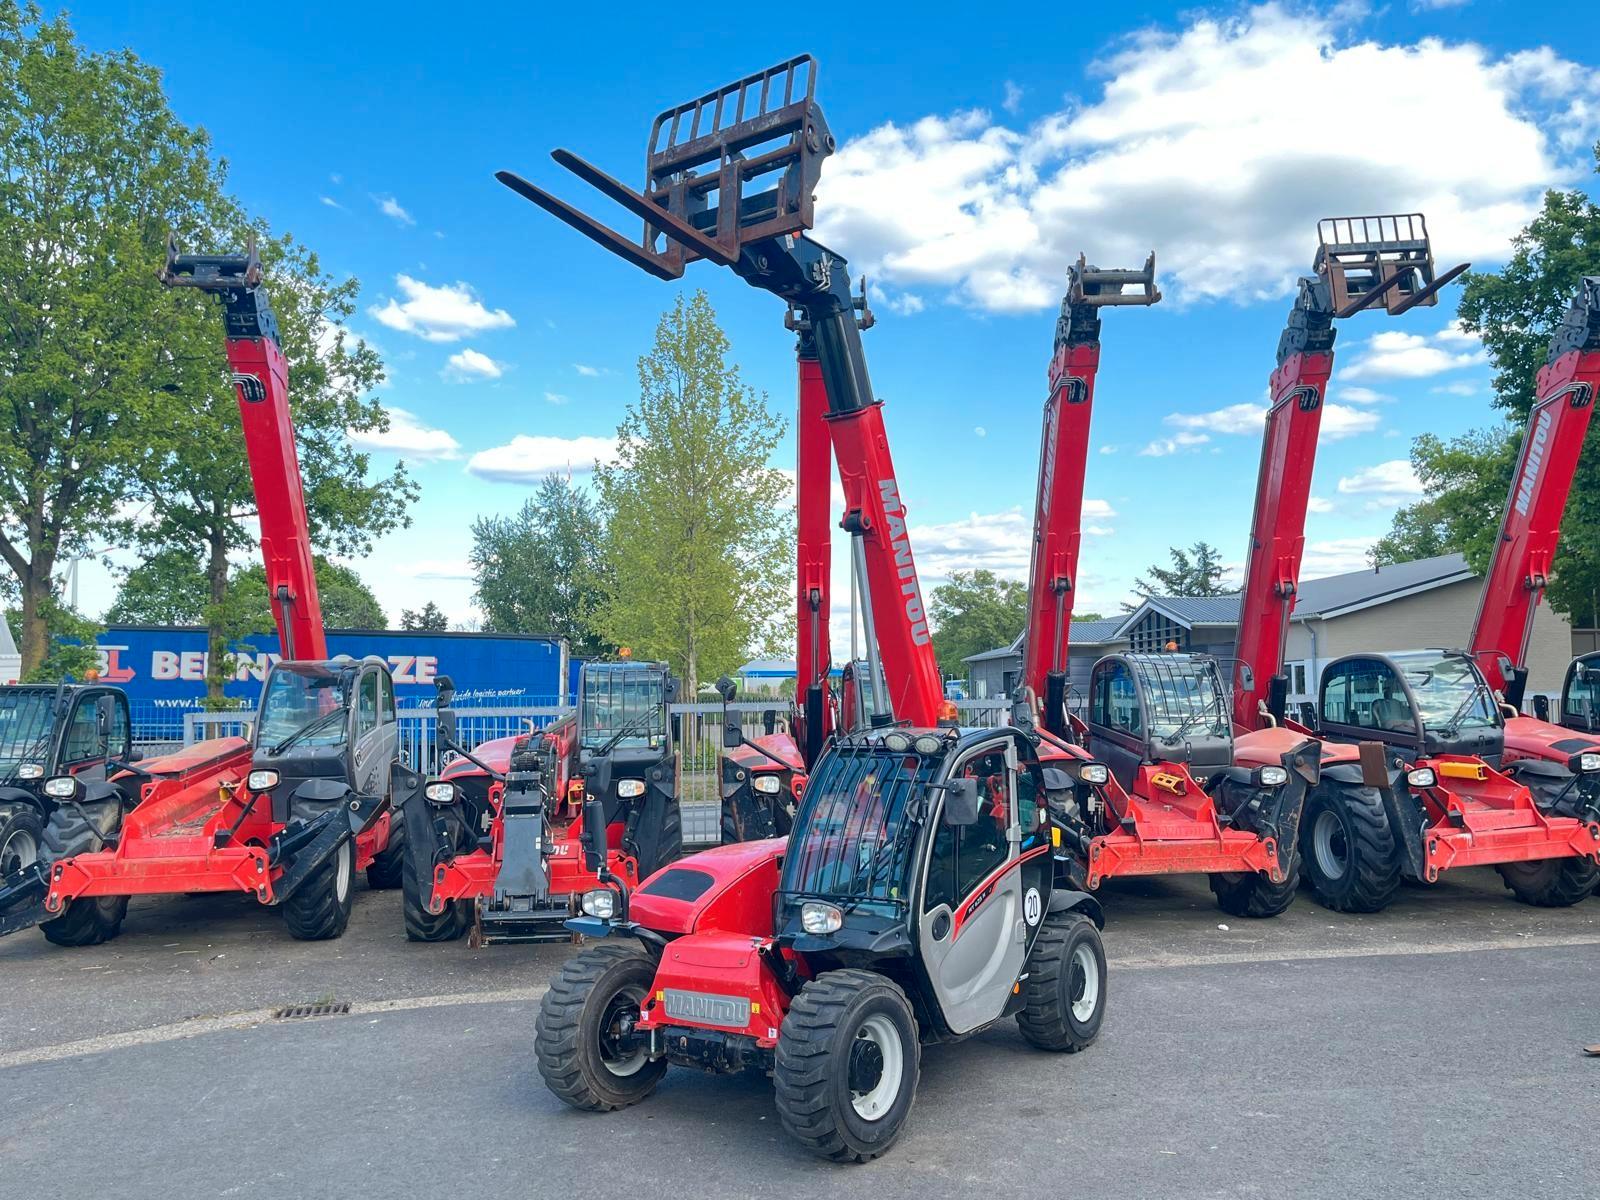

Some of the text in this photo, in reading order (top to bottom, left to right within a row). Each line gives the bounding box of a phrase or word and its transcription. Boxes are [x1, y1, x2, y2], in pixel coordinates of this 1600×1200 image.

[1515, 408, 1552, 517] MANITOU
[878, 478, 929, 647] MANITOU
[1028, 894, 1038, 919] 20
[666, 994, 747, 1022] MANITOU
